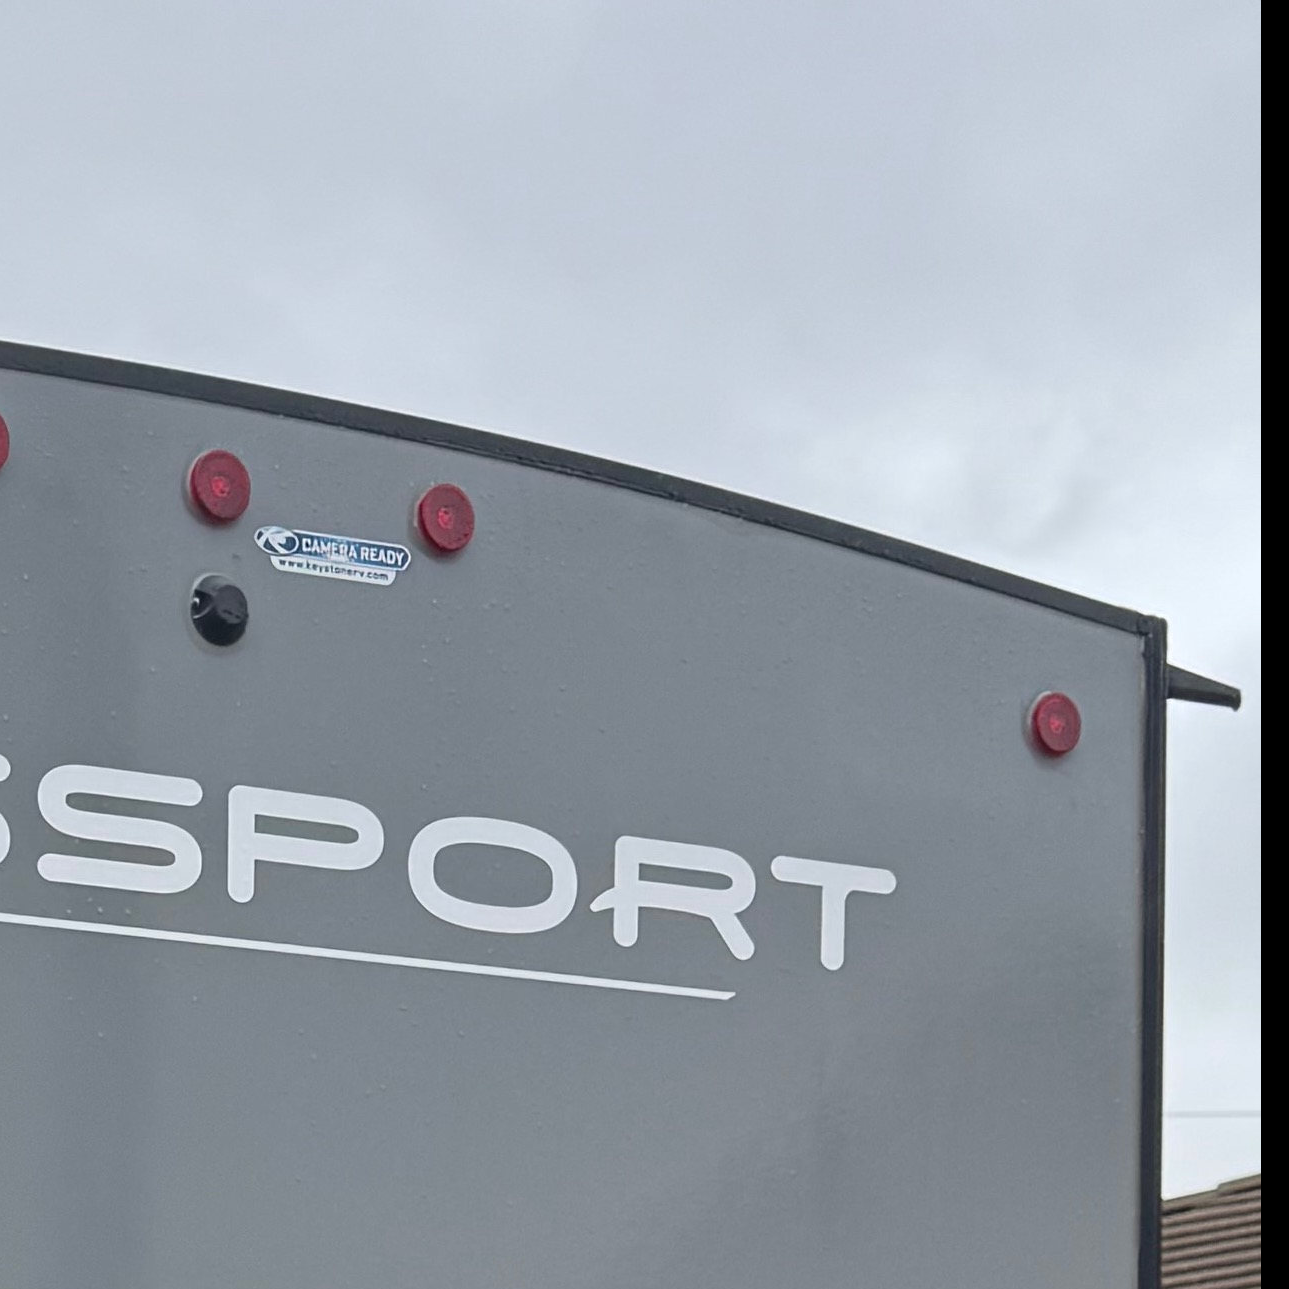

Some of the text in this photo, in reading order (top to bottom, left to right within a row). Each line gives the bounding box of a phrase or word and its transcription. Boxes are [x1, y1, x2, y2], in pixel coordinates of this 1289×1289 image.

[301, 537, 358, 559] CAMERA
[360, 546, 405, 567] READY
[278, 558, 389, 581] www.keystonerv.com
